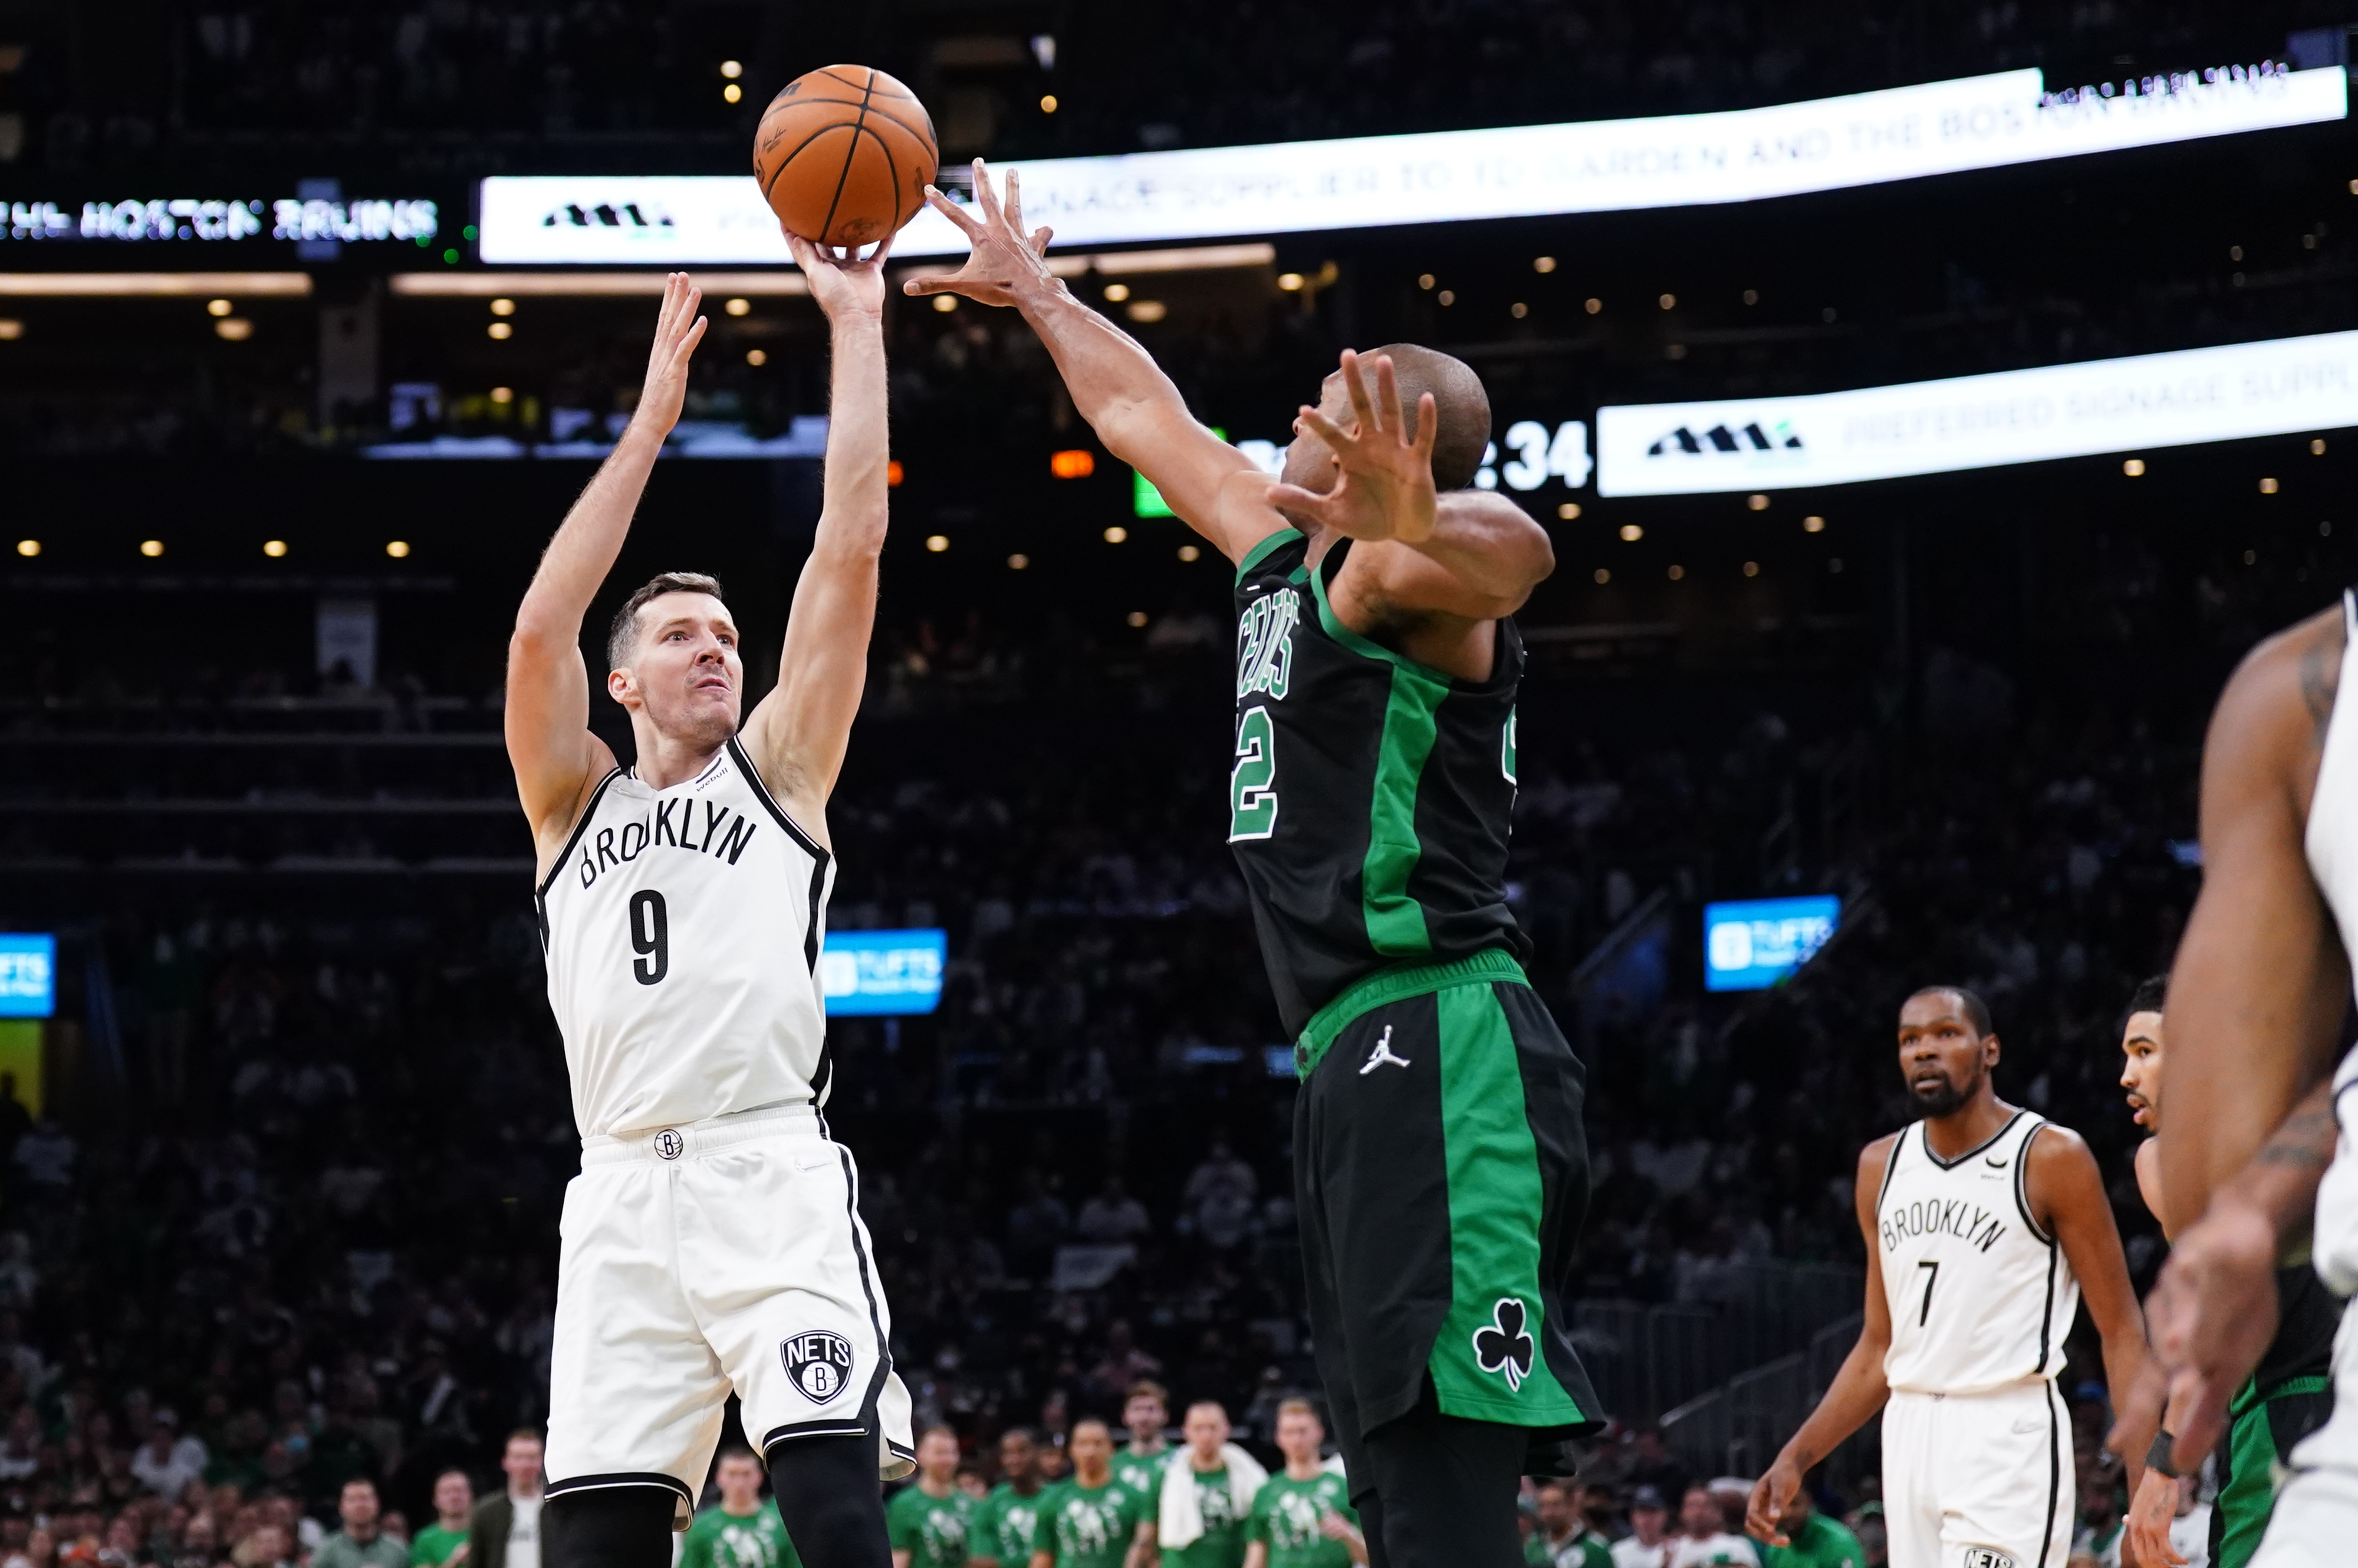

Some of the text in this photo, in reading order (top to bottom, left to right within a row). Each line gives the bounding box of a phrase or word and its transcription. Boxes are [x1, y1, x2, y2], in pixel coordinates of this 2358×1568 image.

[1742, 126, 1832, 170] AND
[629, 889, 668, 985] 9
[663, 1134, 674, 1155] B
[1882, 1199, 2007, 1253] BROOKLYN
[1918, 1261, 1939, 1327] 7
[787, 1335, 850, 1368] NETS
[815, 1367, 827, 1391] B
